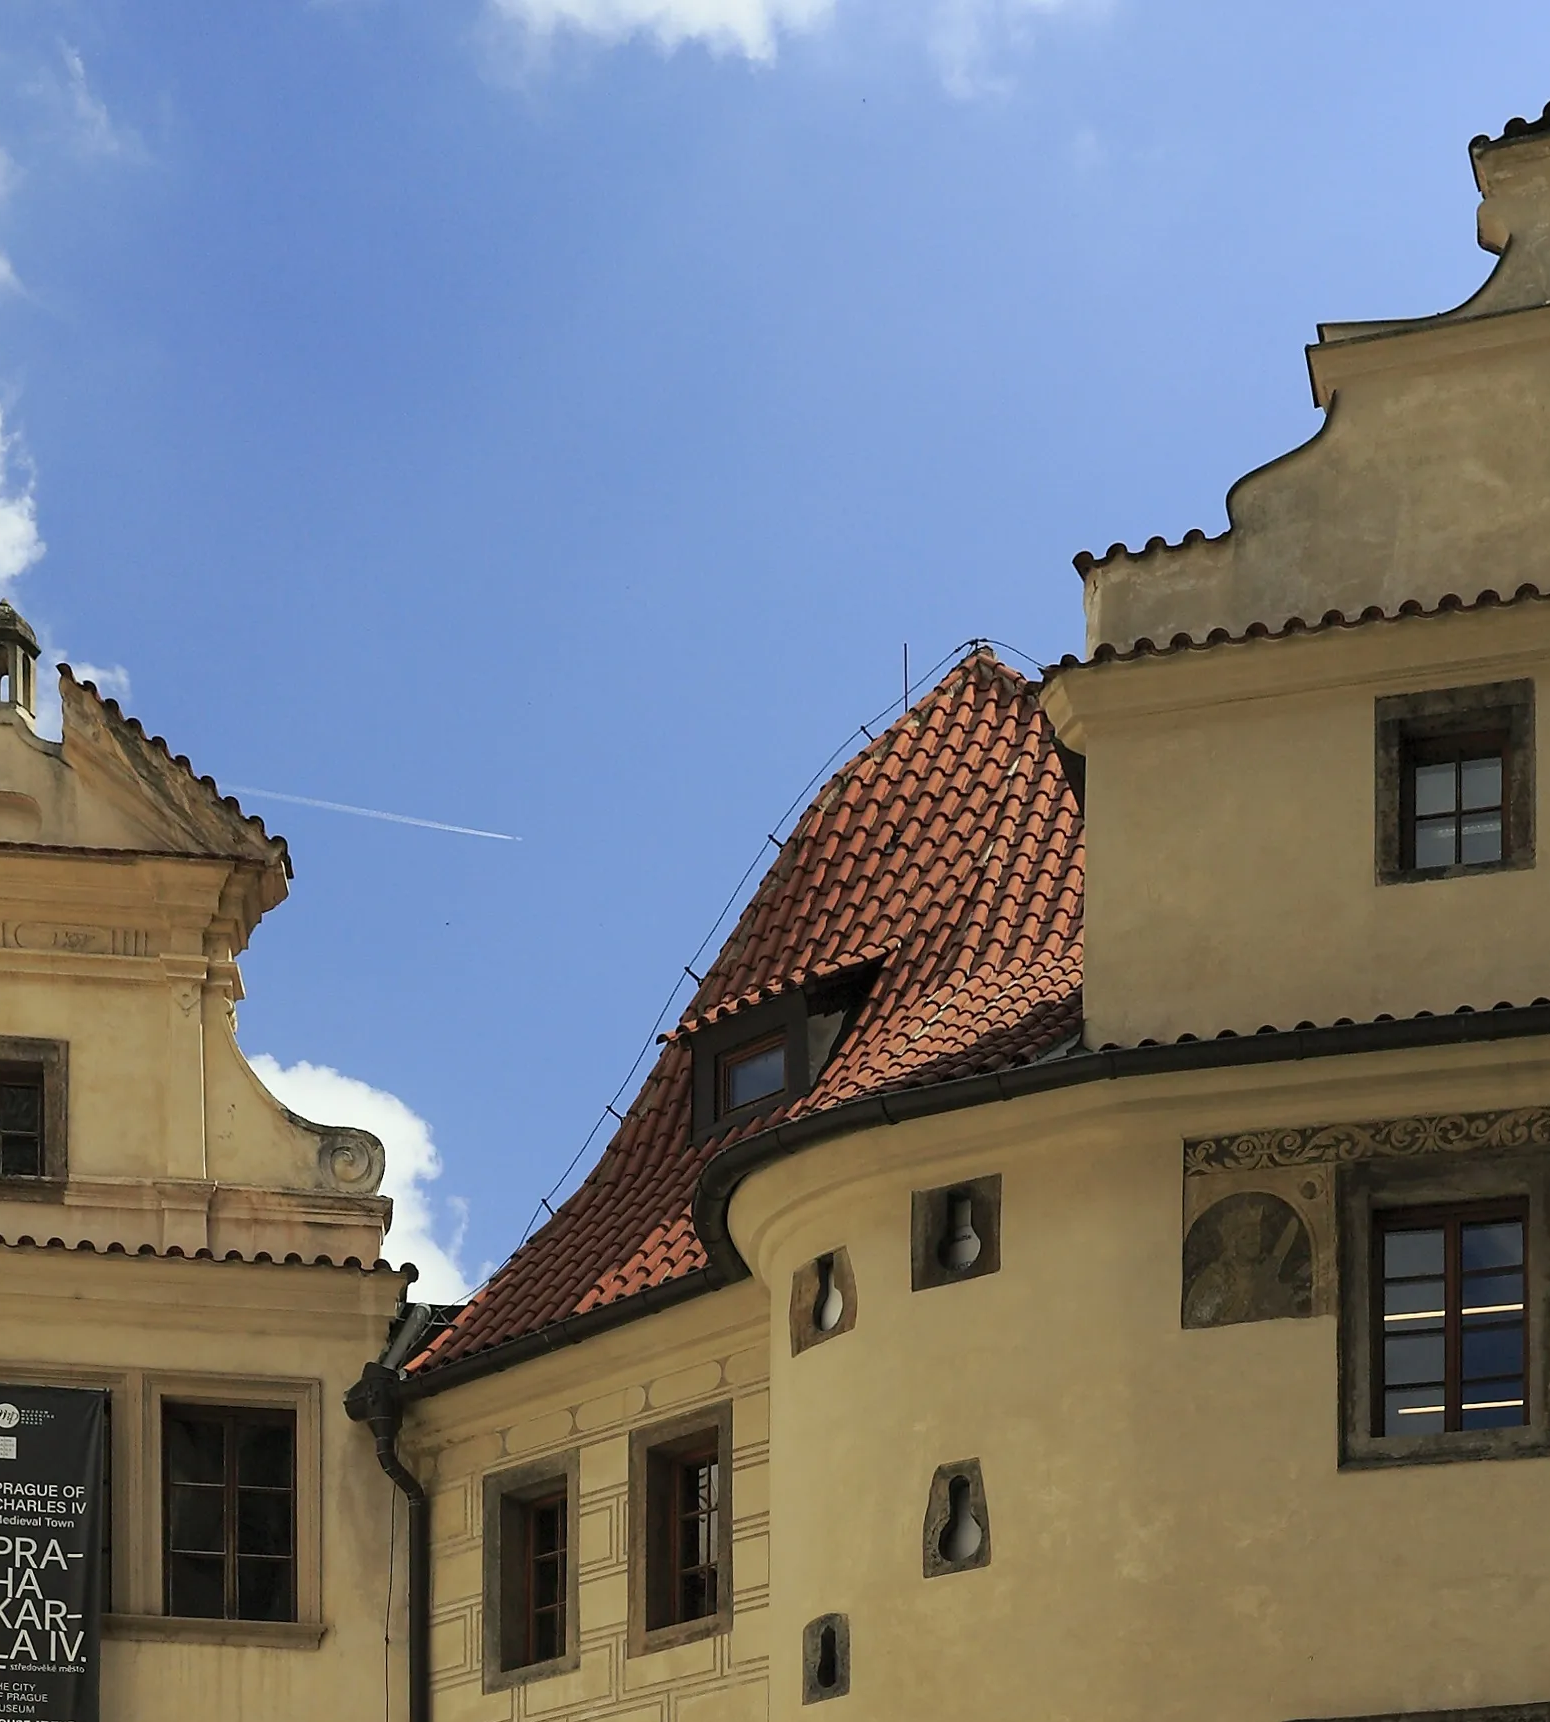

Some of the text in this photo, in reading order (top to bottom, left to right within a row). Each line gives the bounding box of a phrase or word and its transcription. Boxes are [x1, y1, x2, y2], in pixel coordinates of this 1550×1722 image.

[63, 1484, 85, 1498] OF
[71, 1501, 87, 1515] IV
[45, 1516, 75, 1528] Town
[50, 1631, 87, 1663] IV.
[10, 1663, 86, 1674] středověké město
[12, 1682, 37, 1692] CITY
[6, 1692, 48, 1703] PRAGUE
